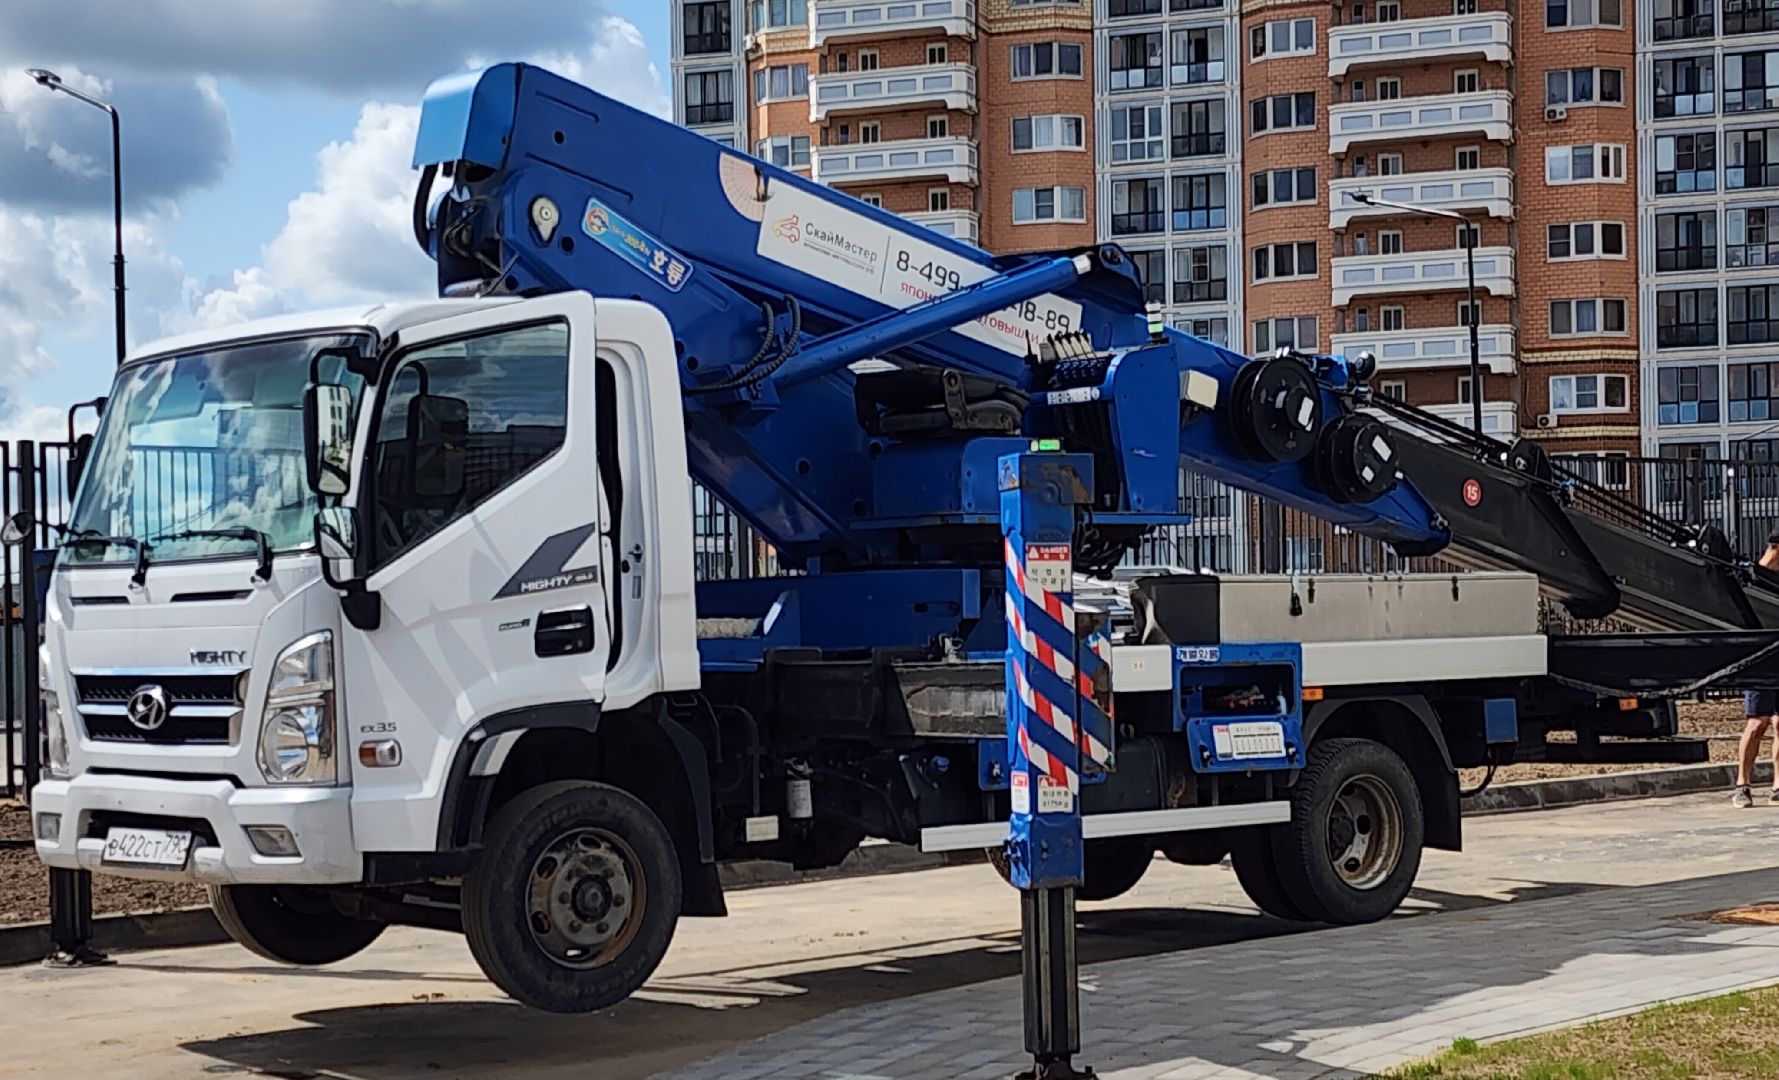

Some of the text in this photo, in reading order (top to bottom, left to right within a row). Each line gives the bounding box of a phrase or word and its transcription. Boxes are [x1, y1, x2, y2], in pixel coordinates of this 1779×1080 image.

[804, 222, 878, 263] СкайМастер
[1467, 485, 1479, 501] 15
[520, 573, 573, 593] MIGHTY
[189, 650, 248, 665] MIGHTY
